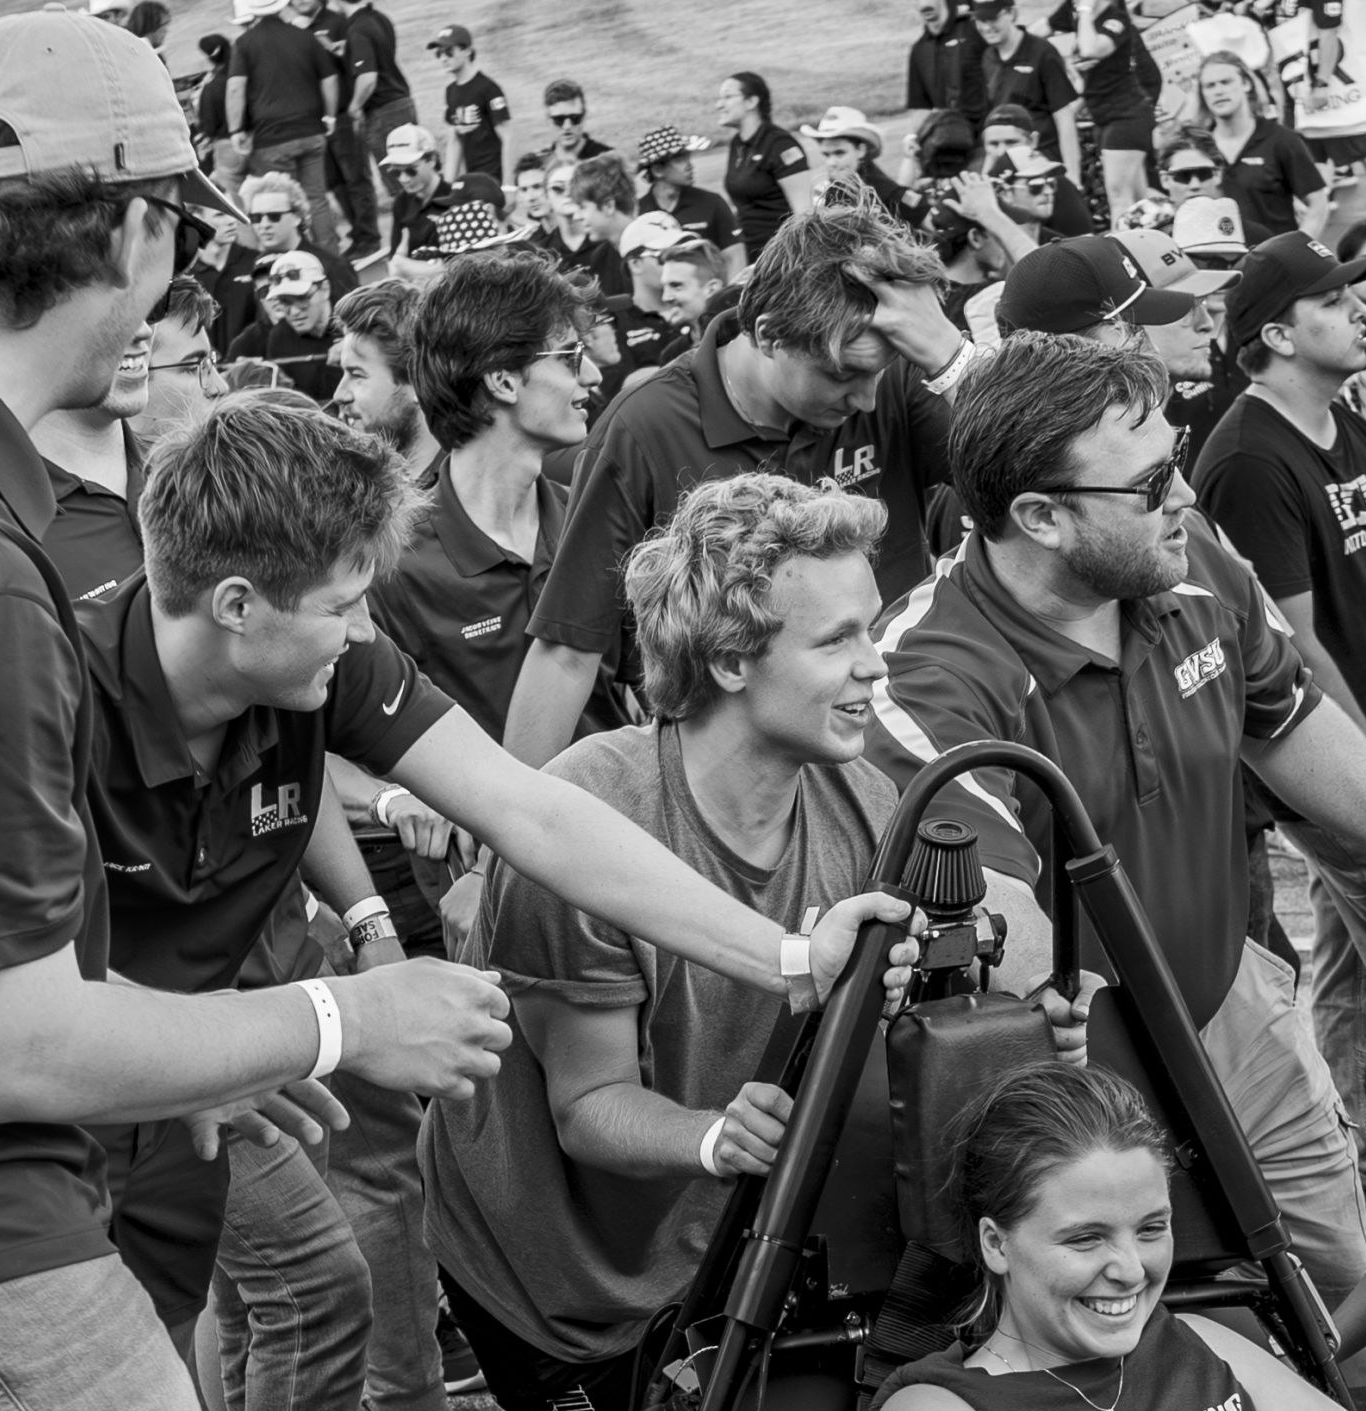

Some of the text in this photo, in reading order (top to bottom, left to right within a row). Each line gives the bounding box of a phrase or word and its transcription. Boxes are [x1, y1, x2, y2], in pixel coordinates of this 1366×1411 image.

[834, 444, 875, 480] LR
[1174, 636, 1225, 692] GVSU
[251, 781, 301, 823] LR
